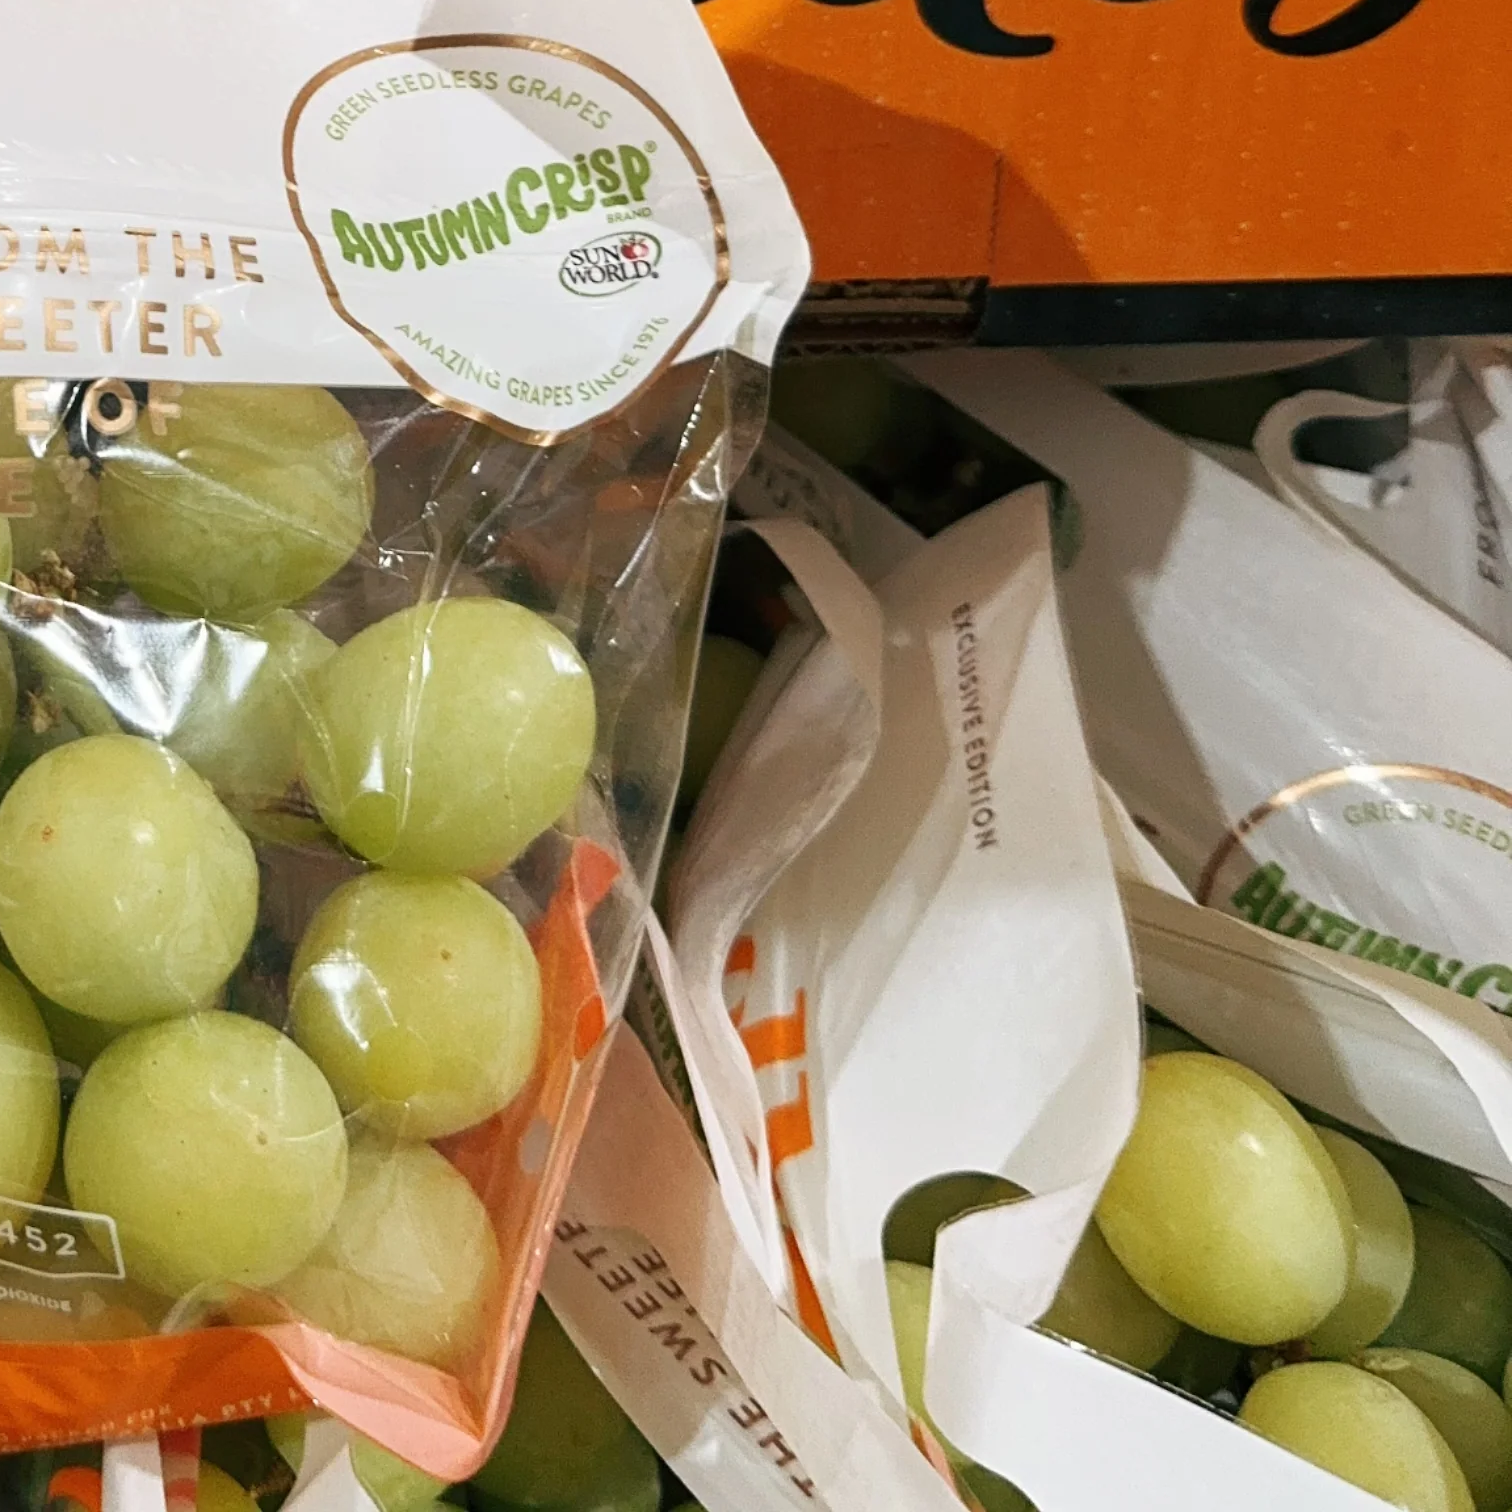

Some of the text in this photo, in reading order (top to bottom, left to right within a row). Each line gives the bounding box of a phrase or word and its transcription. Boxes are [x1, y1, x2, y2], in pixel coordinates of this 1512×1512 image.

[324, 69, 613, 142] GREEN SEEDLESS GRAPES
[605, 206, 653, 225] BRAND
[124, 224, 266, 285] THE
[564, 259, 653, 286] WORLD
[568, 244, 622, 267] SUN
[393, 314, 670, 408] AMAZING GRAPES SINCE 1976
[84, 376, 185, 438] OF
[951, 601, 999, 850] EXCLUSIVE EDITION
[1441, 806, 1512, 861] SEED
[553, 1219, 729, 1387] SWEETE
